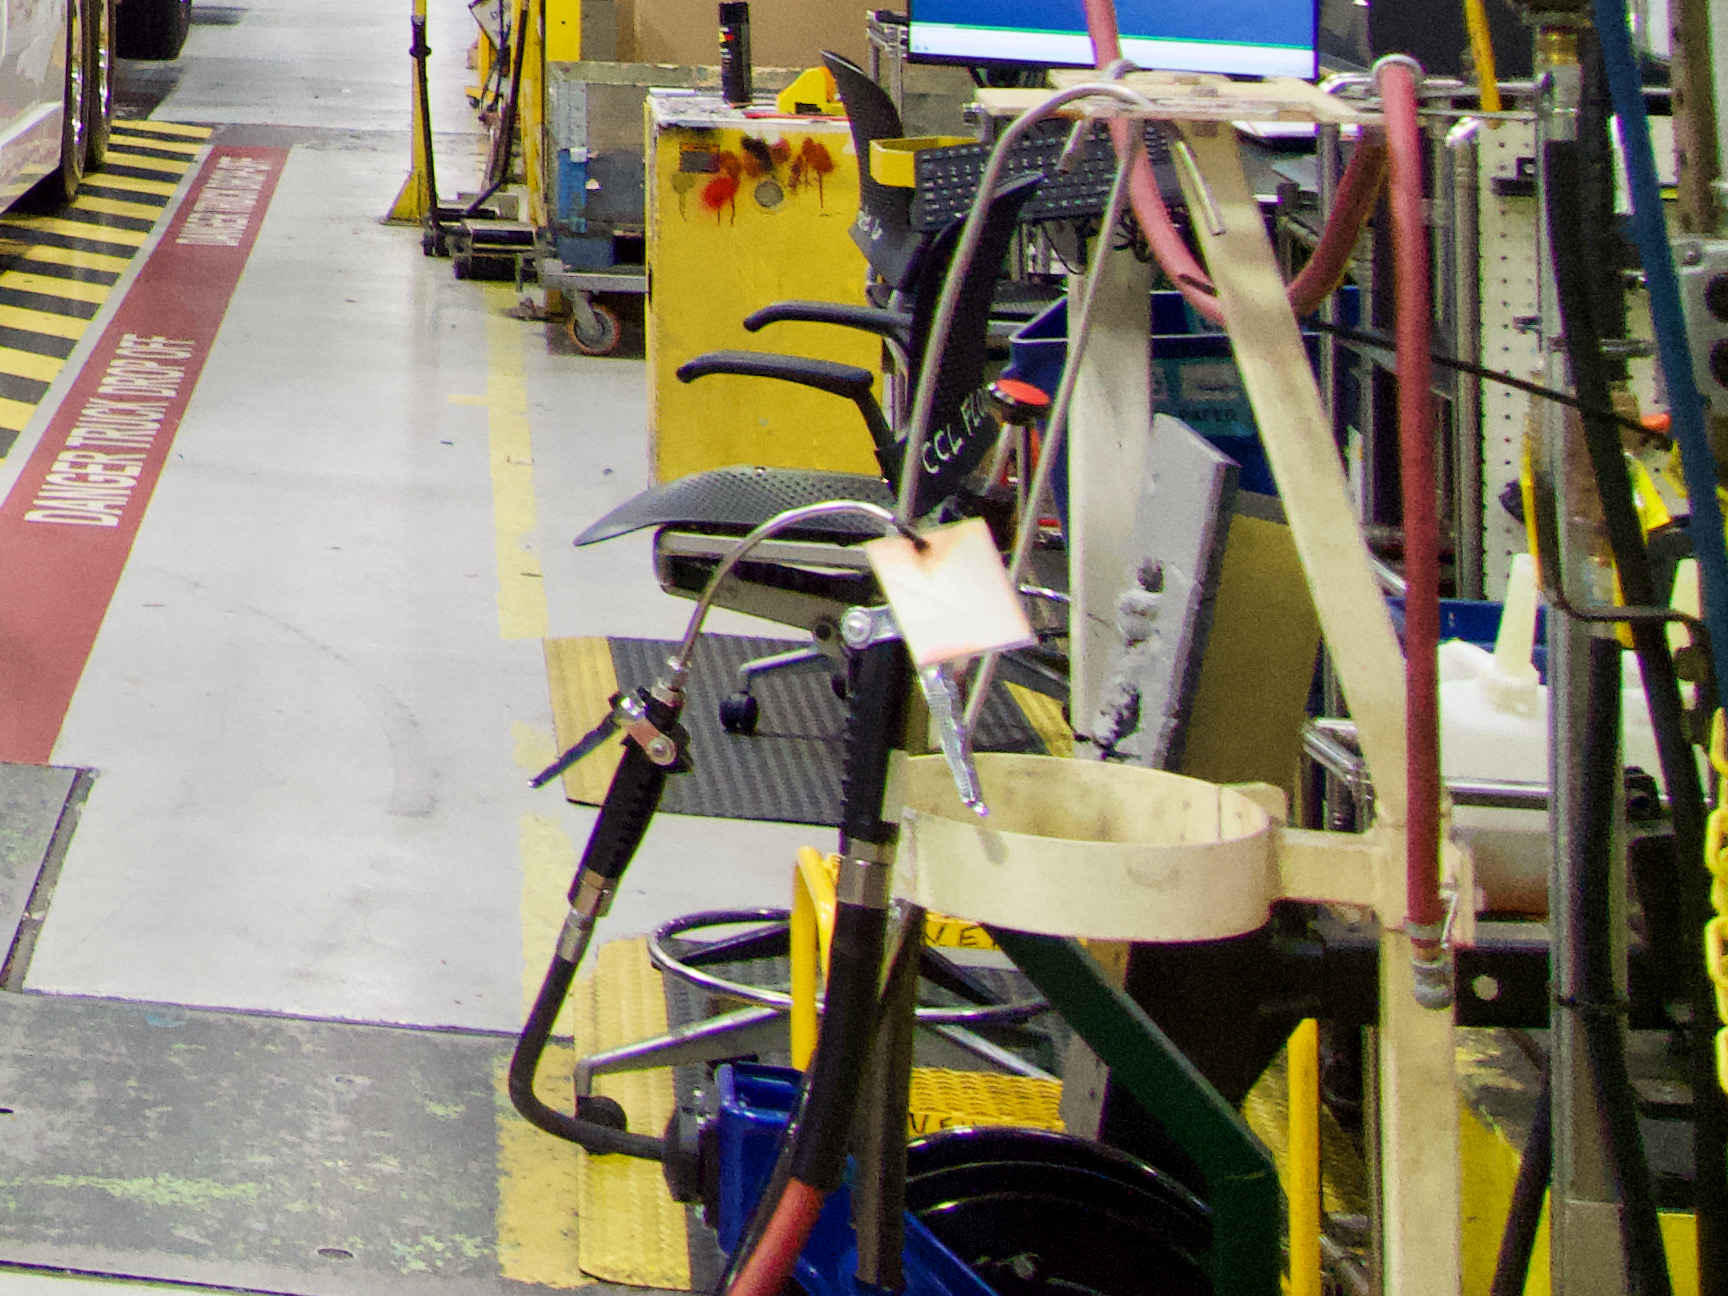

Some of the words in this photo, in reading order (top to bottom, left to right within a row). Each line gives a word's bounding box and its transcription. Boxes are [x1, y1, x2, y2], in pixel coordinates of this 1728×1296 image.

[115, 333, 196, 360] OFF
[97, 358, 186, 399] DROP
[65, 396, 170, 449] TRUCK
[24, 450, 147, 528] DANGER
